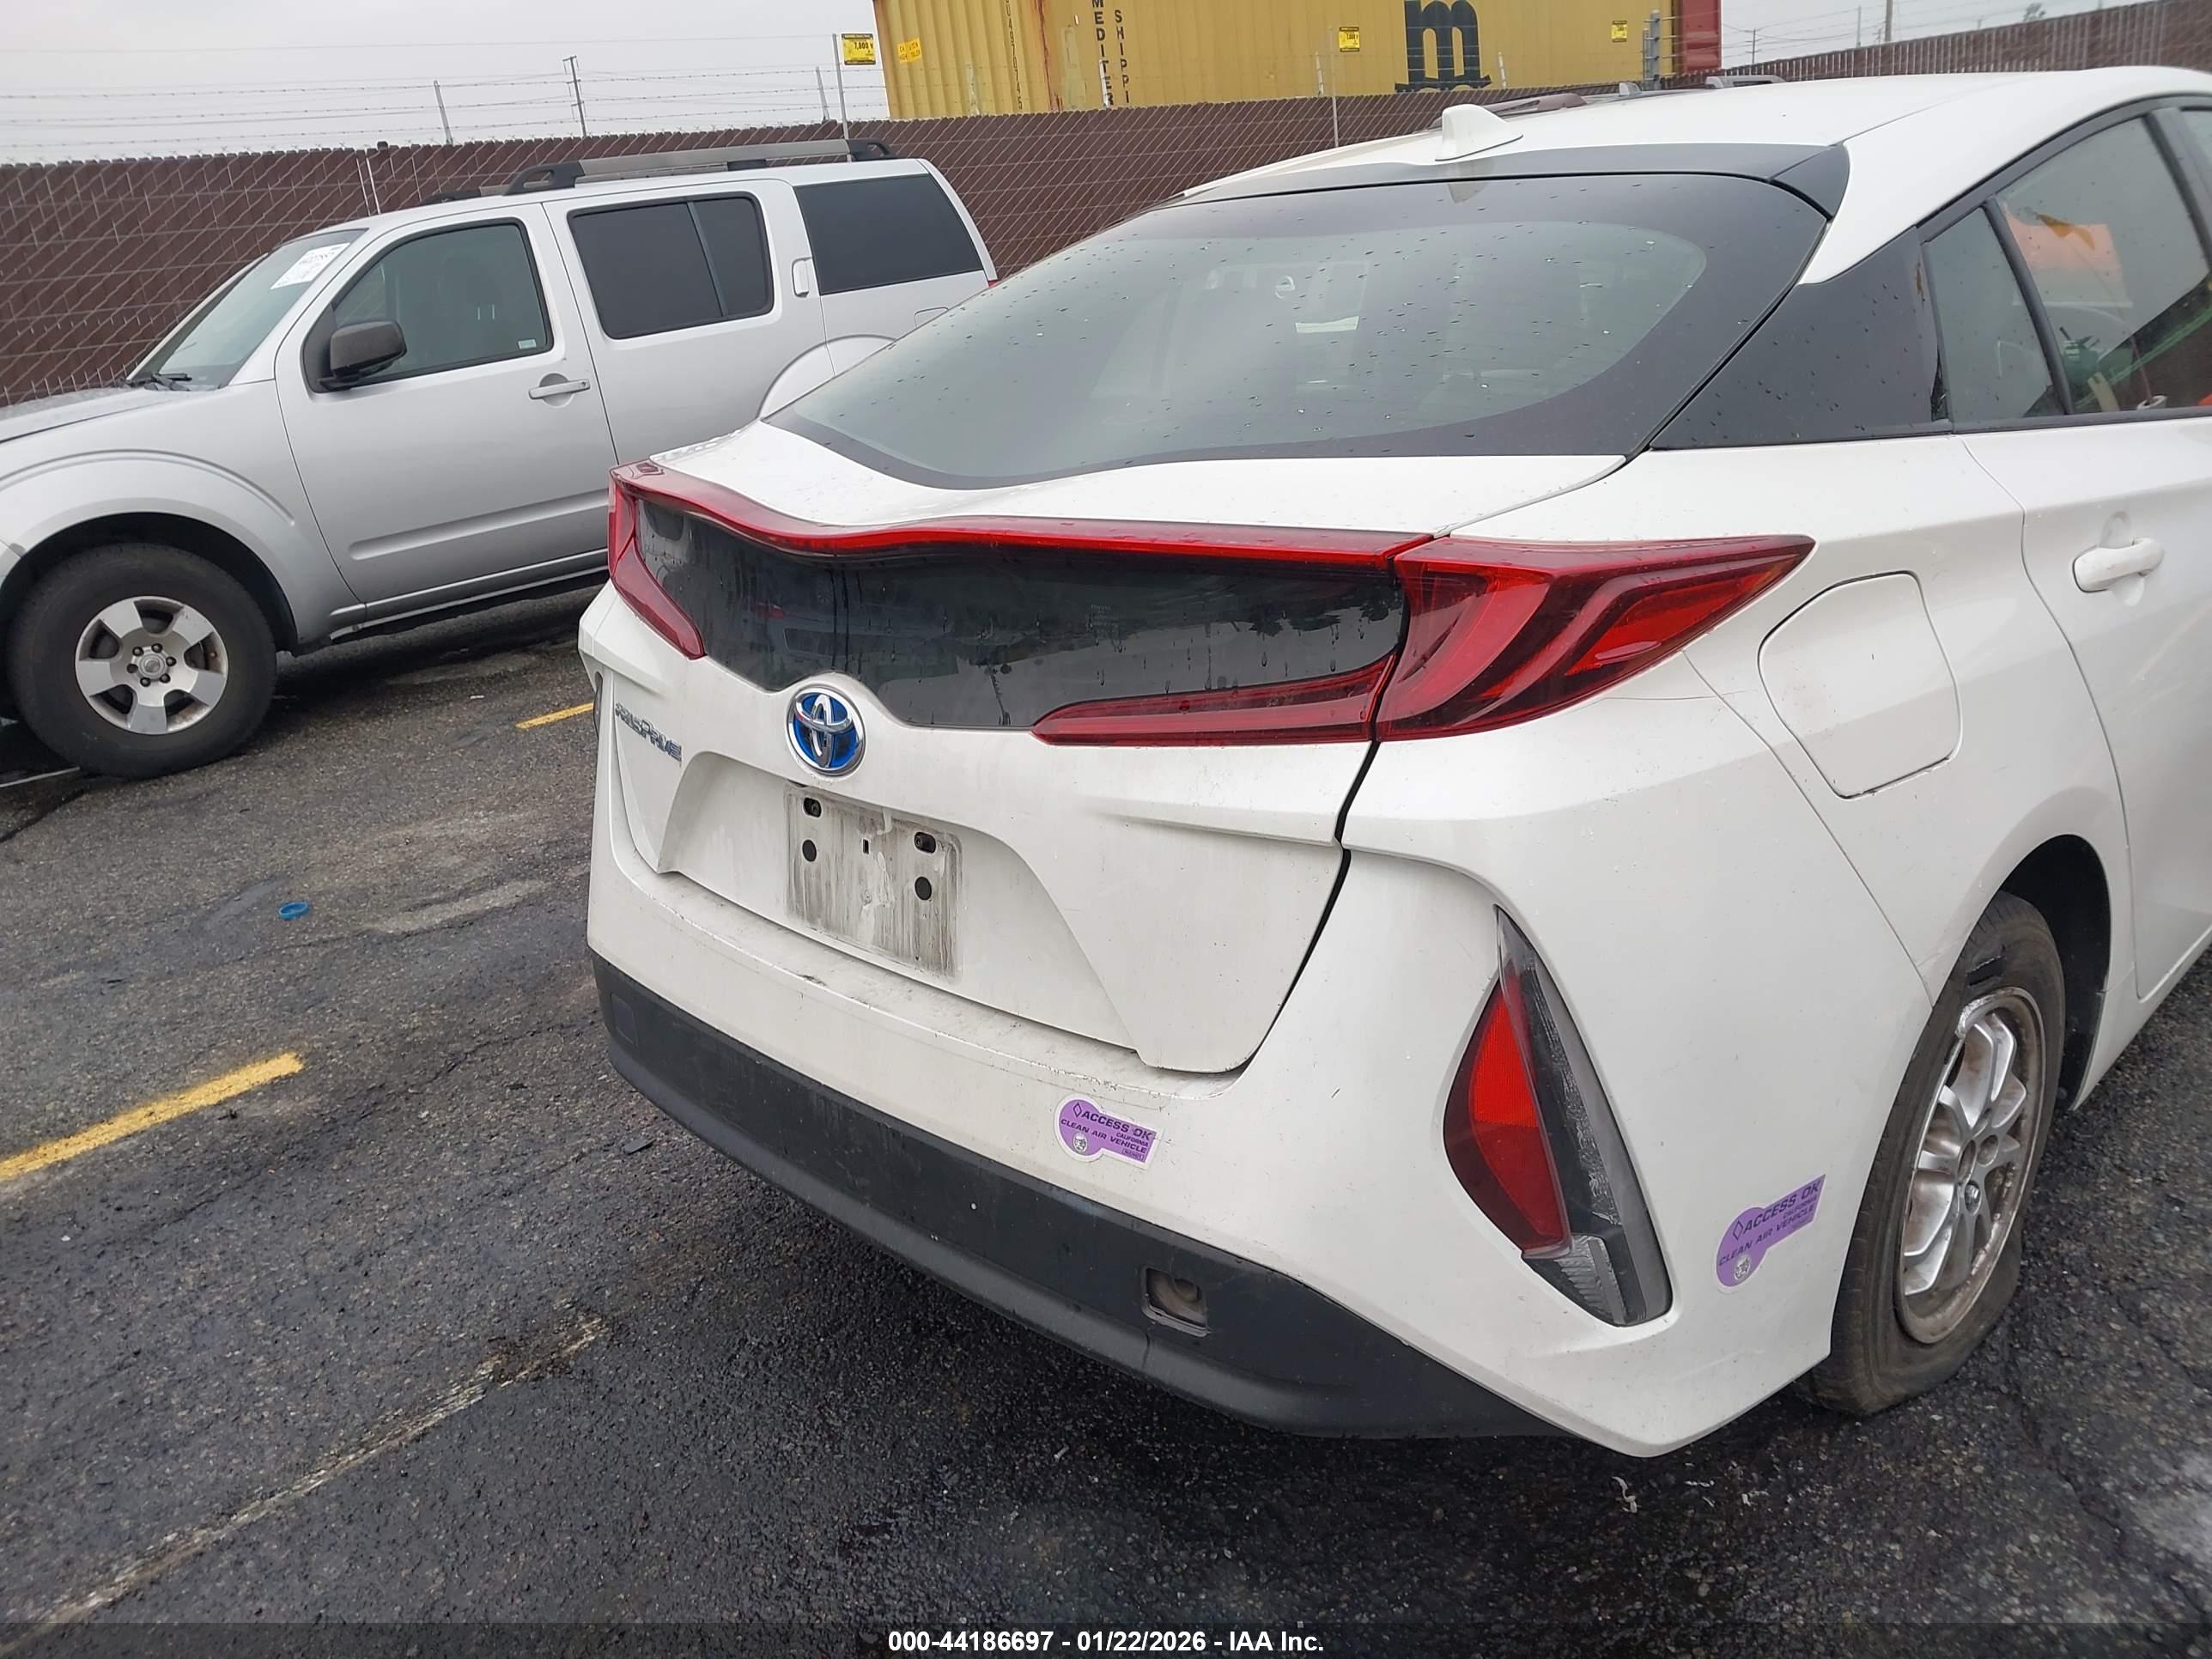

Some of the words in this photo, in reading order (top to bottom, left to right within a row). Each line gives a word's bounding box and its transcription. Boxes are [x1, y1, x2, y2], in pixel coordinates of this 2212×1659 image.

[1060, 1119, 1090, 1133] CLEAN
[1091, 1130, 1107, 1139] AIR
[1110, 1136, 1147, 1154] VEHICLE
[1081, 1110, 1130, 1133] ACCESS
[1133, 1128, 1152, 1141] OK
[1115, 1132, 1149, 1147] CALIFORNIA
[1743, 1194, 1797, 1235] ACCESS
[1801, 1179, 1821, 1200] OK
[1719, 1240, 1753, 1267] CLEAN
[1755, 1228, 1773, 1244] AIR
